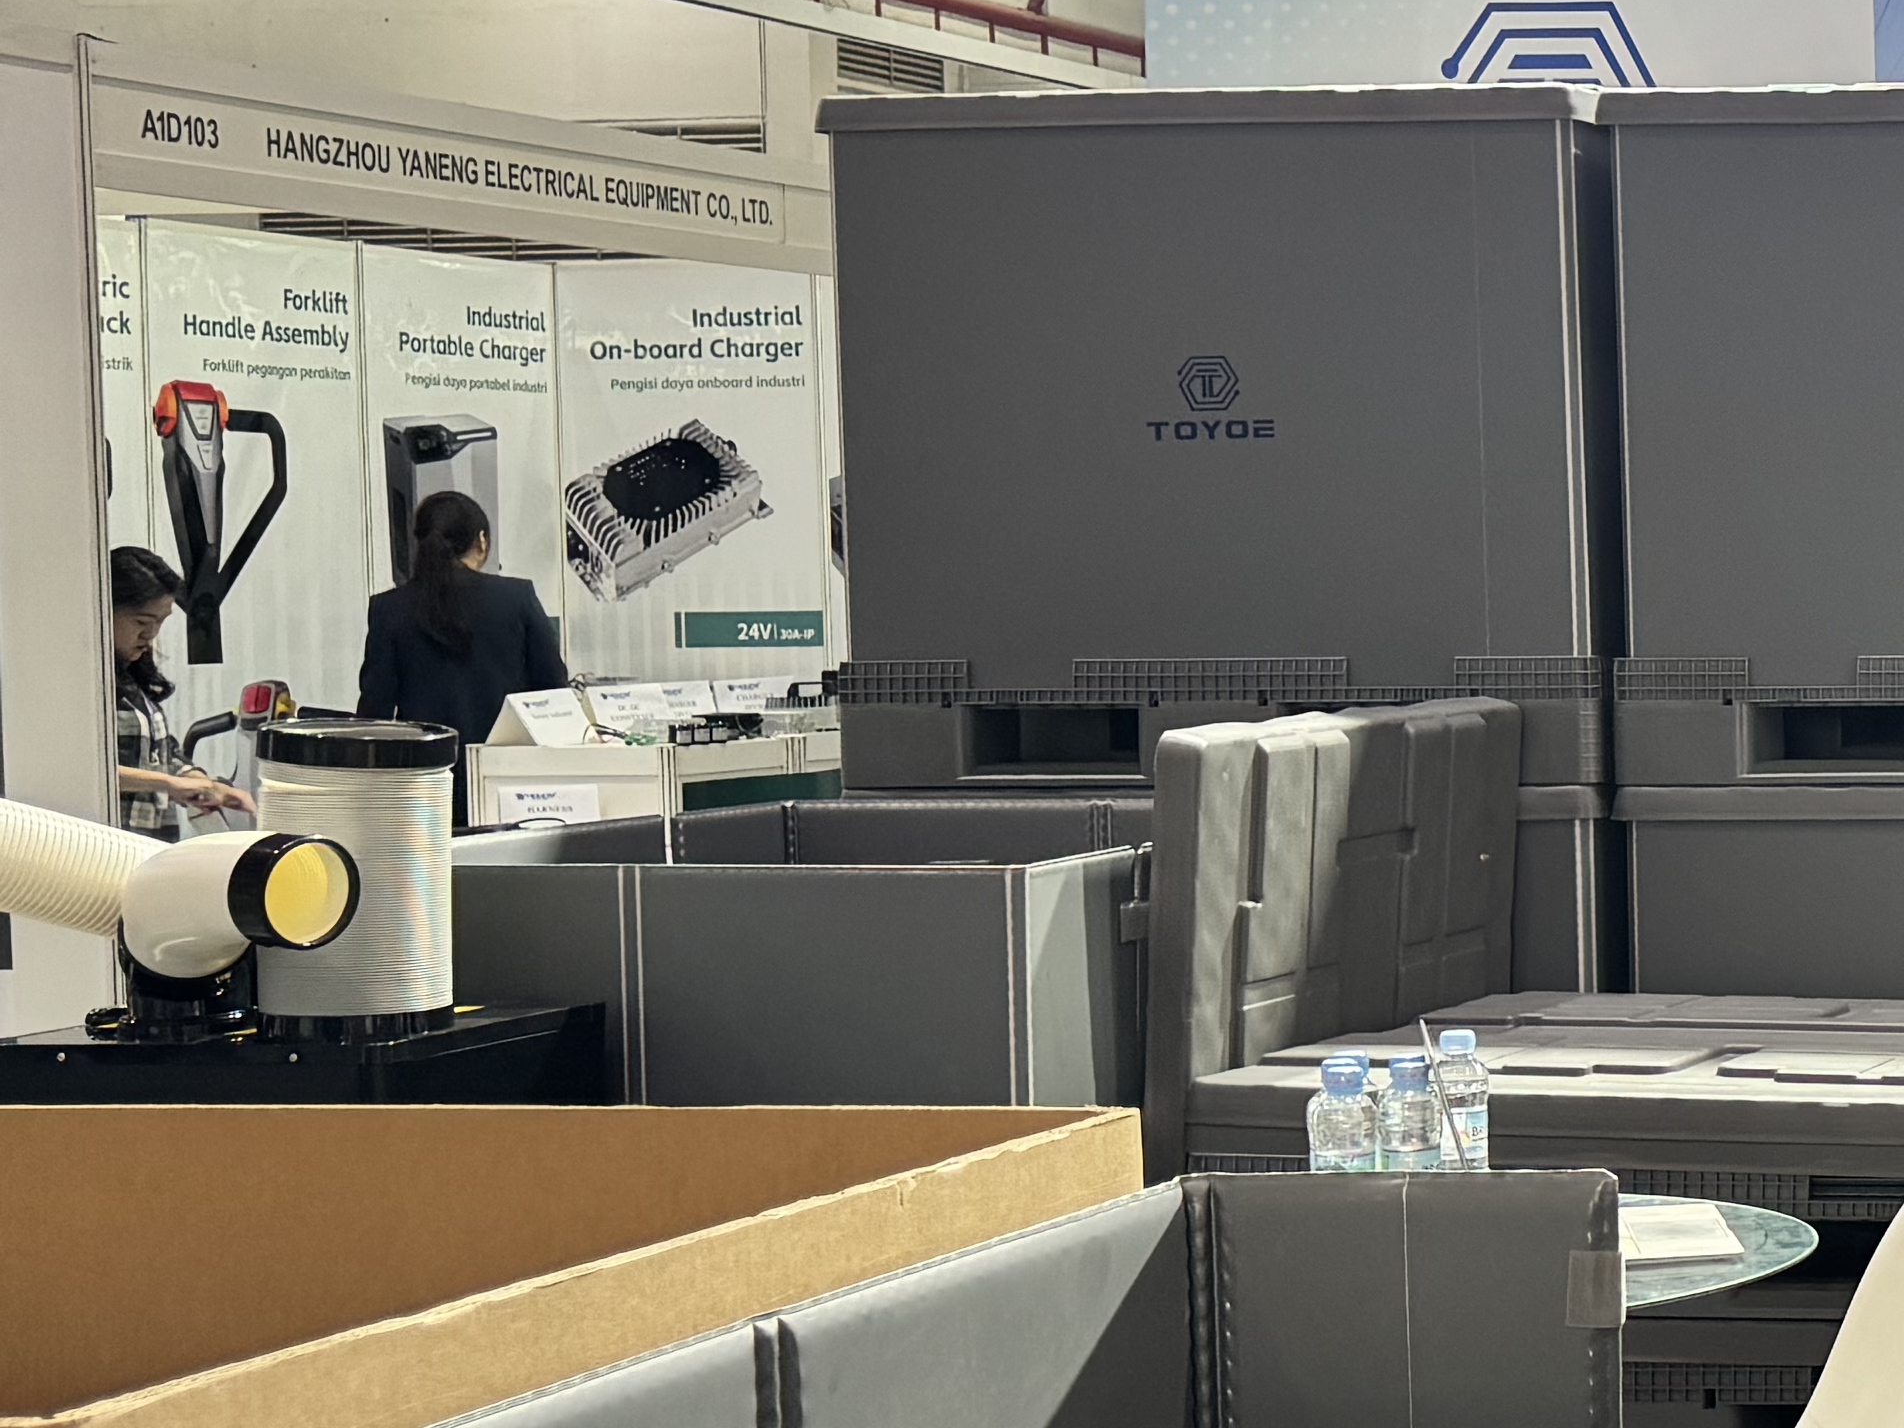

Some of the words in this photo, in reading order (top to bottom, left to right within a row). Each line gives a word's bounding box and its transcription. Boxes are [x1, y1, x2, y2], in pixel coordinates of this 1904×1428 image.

[141, 109, 219, 149] A1D103
[266, 127, 391, 174] HANGZHOU
[396, 146, 480, 186] YANENG
[484, 159, 600, 204] ELECTRICAL
[604, 177, 701, 217] EQUIPMENT
[706, 192, 738, 226] CO.,
[741, 197, 774, 226] LTD.
[283, 288, 349, 315] Forklift
[466, 305, 547, 332] Industrial
[691, 304, 803, 328] Industrial
[183, 313, 256, 341] Handle
[261, 320, 350, 353] Assembly
[398, 331, 475, 358] Portable
[479, 337, 547, 367] Charger
[589, 337, 703, 361] On-board
[709, 337, 804, 363] Charger
[202, 358, 245, 374] Forklift
[610, 377, 658, 393] Pengisi
[660, 377, 694, 392] daya
[697, 375, 753, 390] onboard
[756, 374, 805, 388] industri
[1146, 419, 1276, 442] TOYOE
[736, 622, 772, 641] 24V
